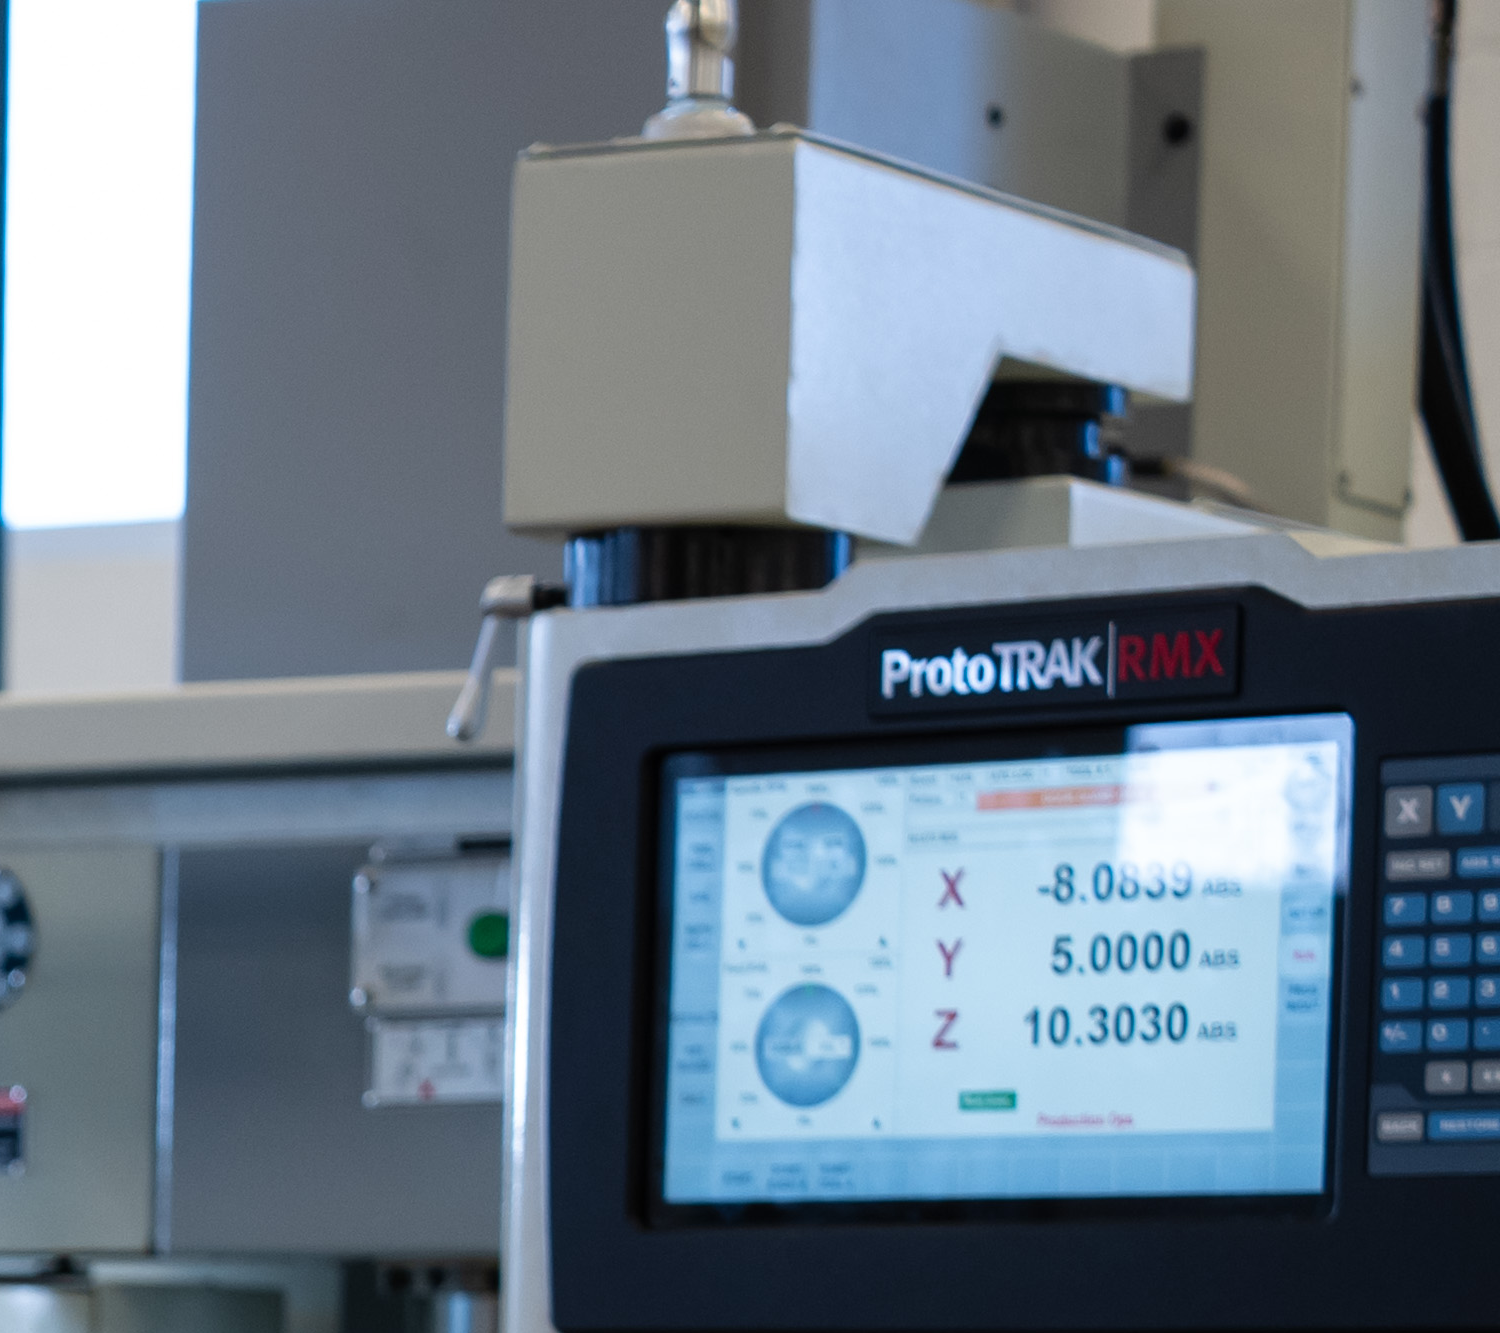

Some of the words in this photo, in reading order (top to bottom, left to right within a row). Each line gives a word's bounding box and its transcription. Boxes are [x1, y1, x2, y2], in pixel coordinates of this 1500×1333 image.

[882, 635, 1103, 699] ProtoTRAK
[1118, 629, 1224, 682] RMX
[1397, 797, 1419, 823] X
[1449, 794, 1472, 821] Y
[938, 867, 965, 908] X
[1038, 861, 1193, 905] -8.0839
[937, 938, 962, 977] Y
[1050, 930, 1191, 974] 5.0000
[1199, 949, 1240, 967] ABS
[932, 1008, 959, 1049] Z
[1024, 1002, 1189, 1046] 10.3030
[1198, 1022, 1238, 1040] ABS
